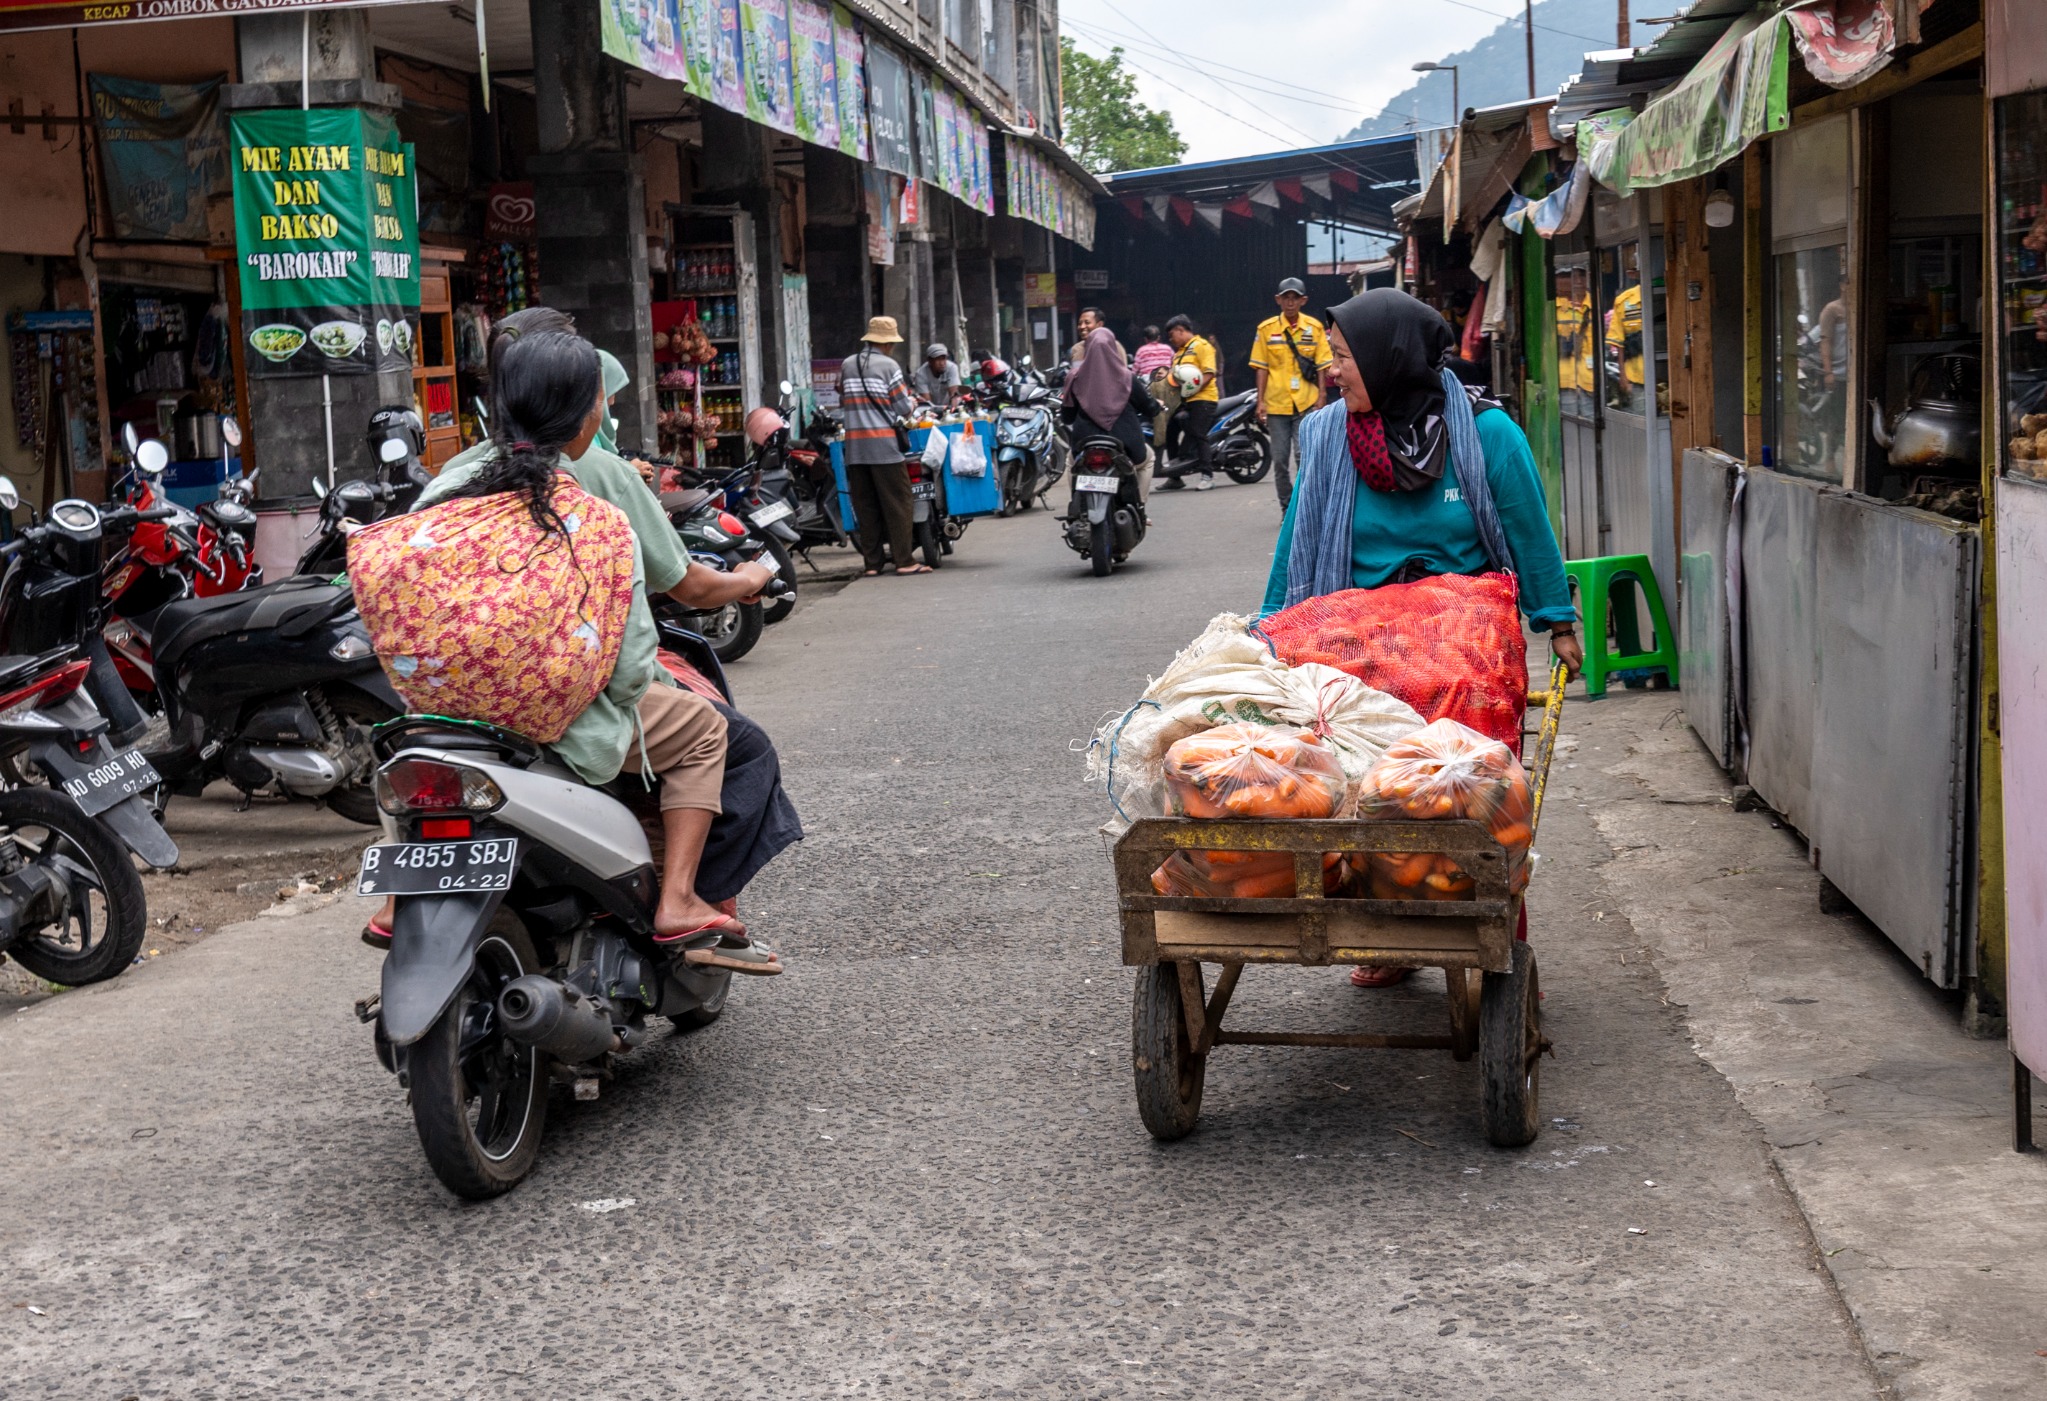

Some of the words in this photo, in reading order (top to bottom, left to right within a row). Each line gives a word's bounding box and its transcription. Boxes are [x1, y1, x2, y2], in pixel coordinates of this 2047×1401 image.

[83, 4, 131, 20] KECAP
[136, 0, 221, 17] LOMBOK
[240, 146, 282, 172] MIE
[288, 145, 351, 172] AYAM
[273, 180, 320, 206] DAN
[260, 213, 339, 241] BAKSO
[1444, 488, 1460, 502] PKK
[67, 778, 88, 799] AD
[87, 761, 125, 788] 6009
[124, 750, 146, 770] HO
[364, 847, 381, 871] B
[393, 845, 457, 869] 4855
[467, 840, 514, 865] SBJ
